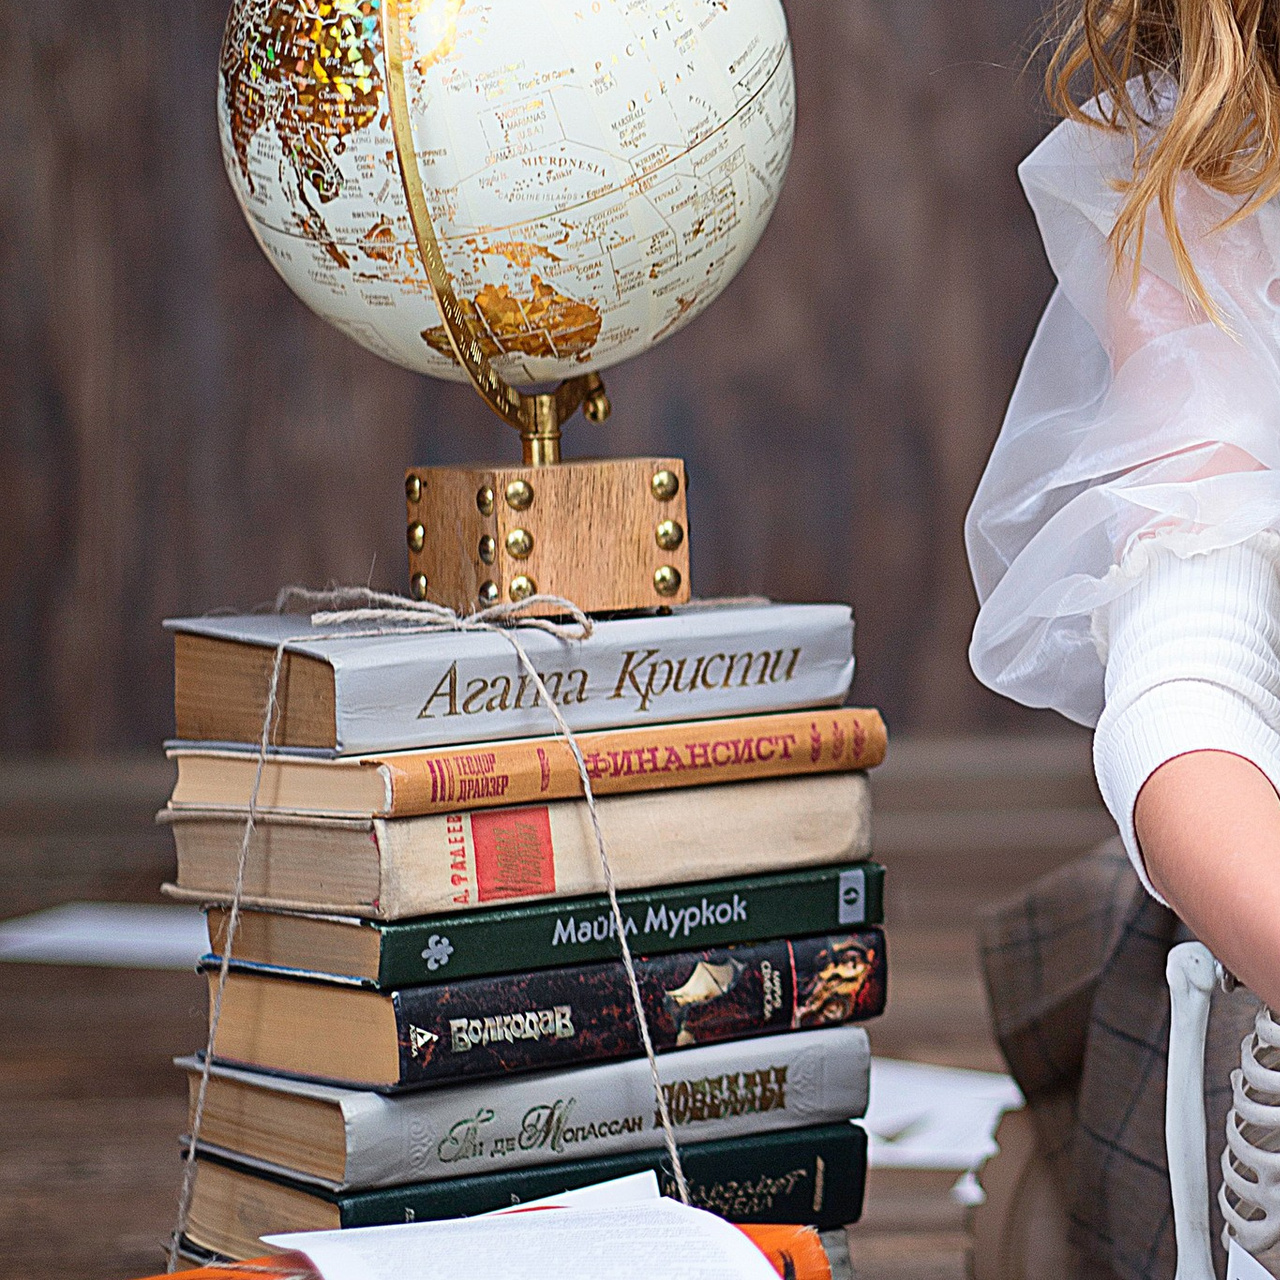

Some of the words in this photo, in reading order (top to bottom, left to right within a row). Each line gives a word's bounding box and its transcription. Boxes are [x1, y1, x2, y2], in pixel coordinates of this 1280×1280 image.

[627, 60, 696, 113] OCEAN
[507, 110, 547, 131] MARIANAS
[416, 148, 448, 159] LIPPINES
[422, 158, 436, 167] SEA
[586, 181, 615, 199] Equator
[585, 270, 601, 281] SEA
[416, 659, 589, 720] Агата
[605, 647, 802, 712] Кристи
[583, 733, 796, 780] ФИНАНСИСТ
[456, 774, 509, 802] ДРАЙЗЕР
[551, 910, 638, 946] Майкл
[644, 893, 748, 939] Муркок
[653, 1065, 788, 1130] НОВЕЛЛЫ
